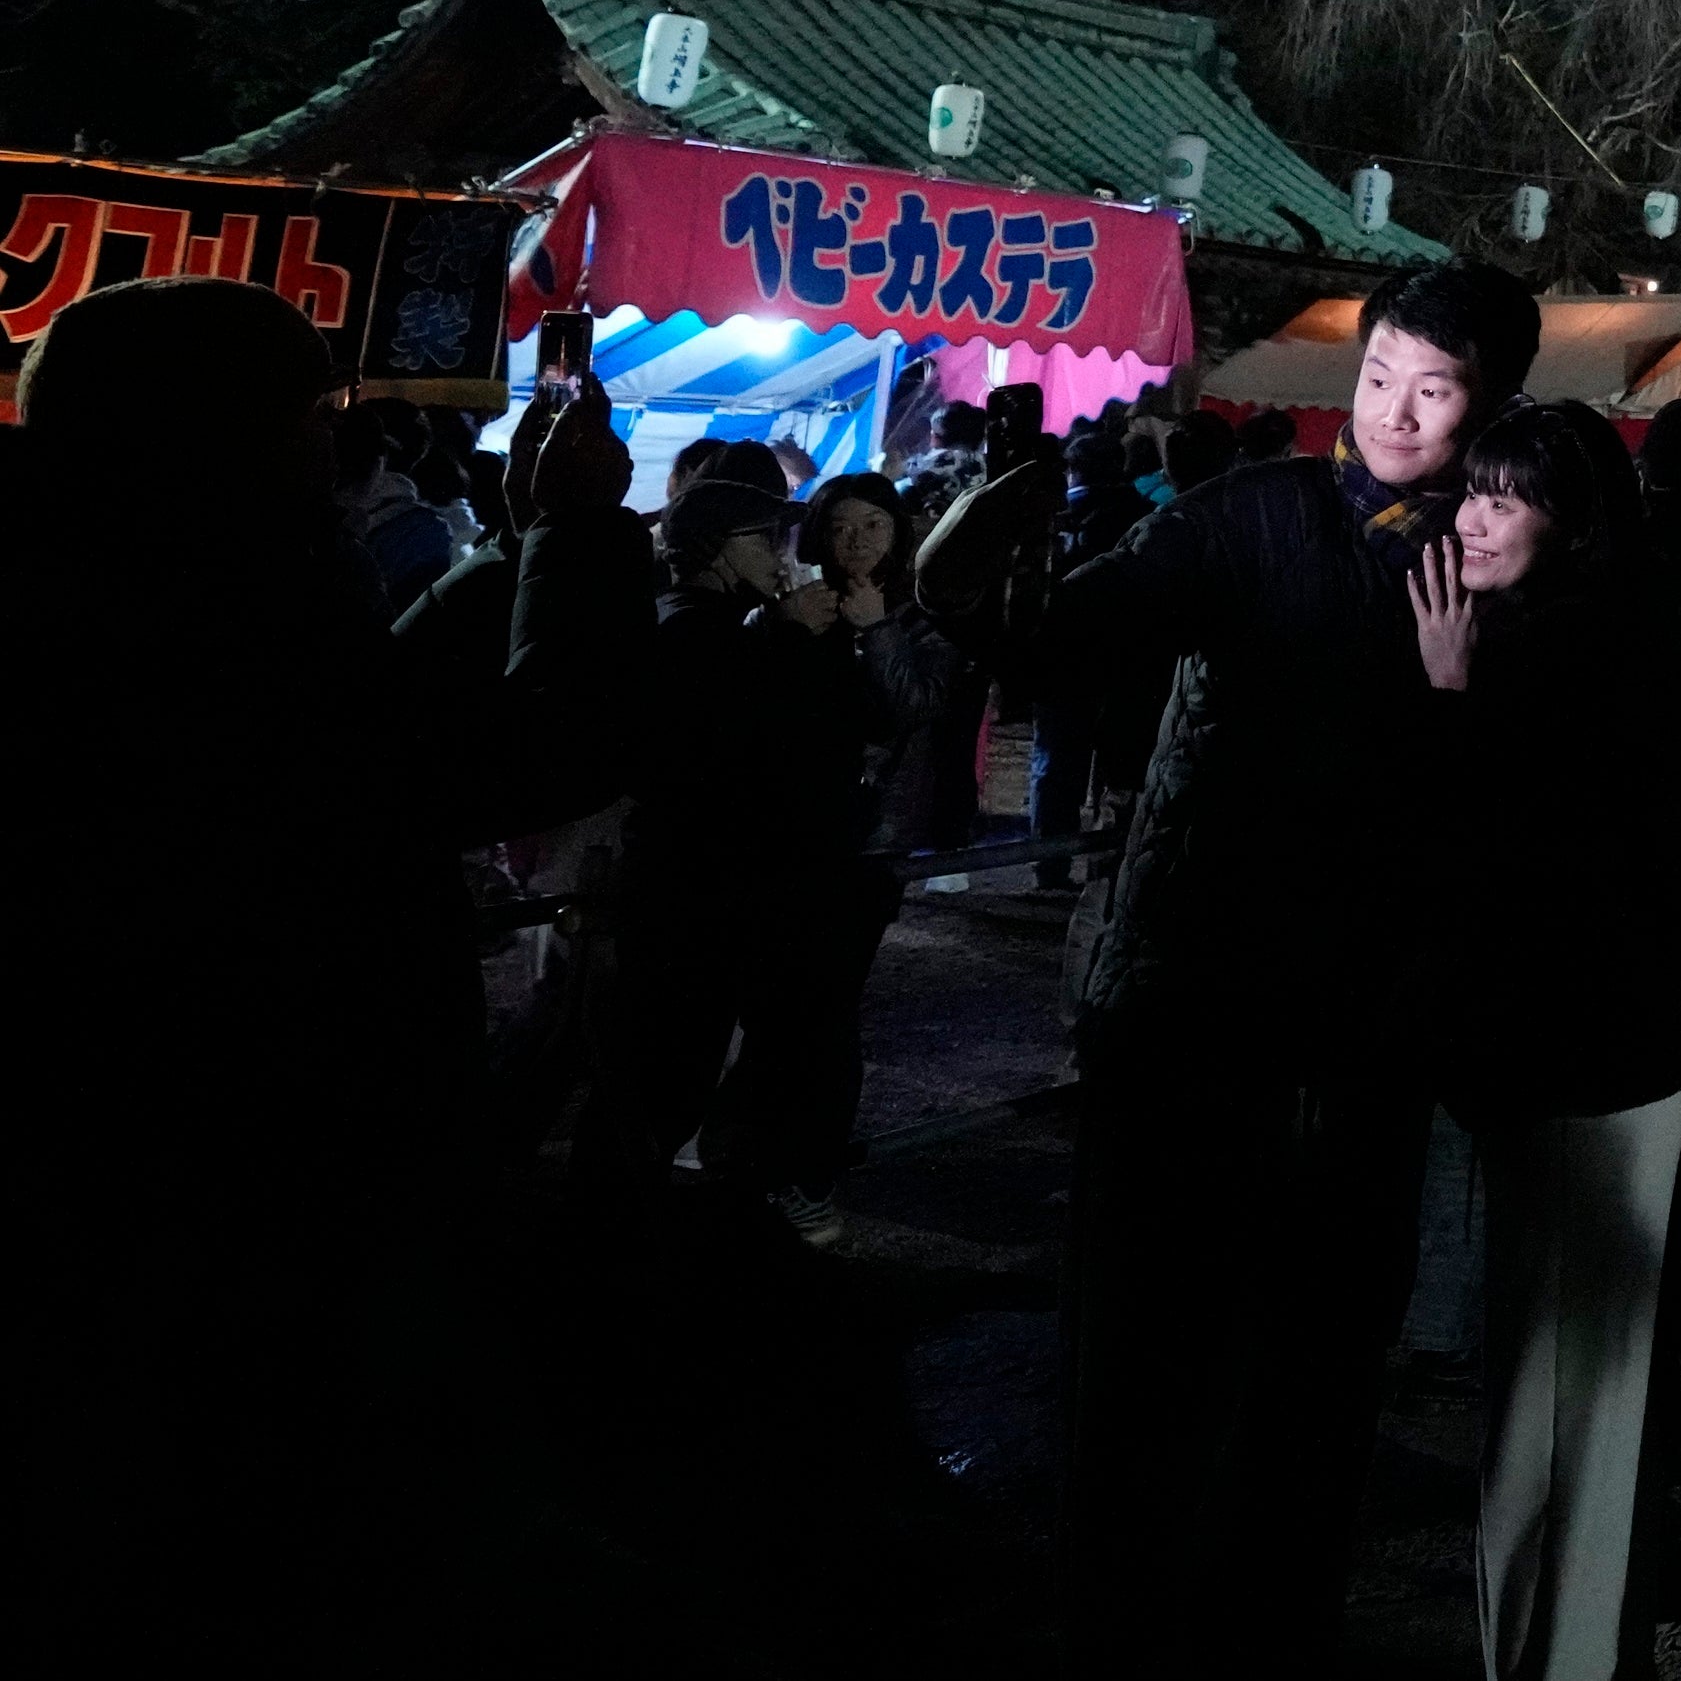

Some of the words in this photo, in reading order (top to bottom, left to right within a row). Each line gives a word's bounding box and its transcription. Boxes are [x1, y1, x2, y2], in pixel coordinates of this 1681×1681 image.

[719, 171, 1100, 334] ベビーカステラ
